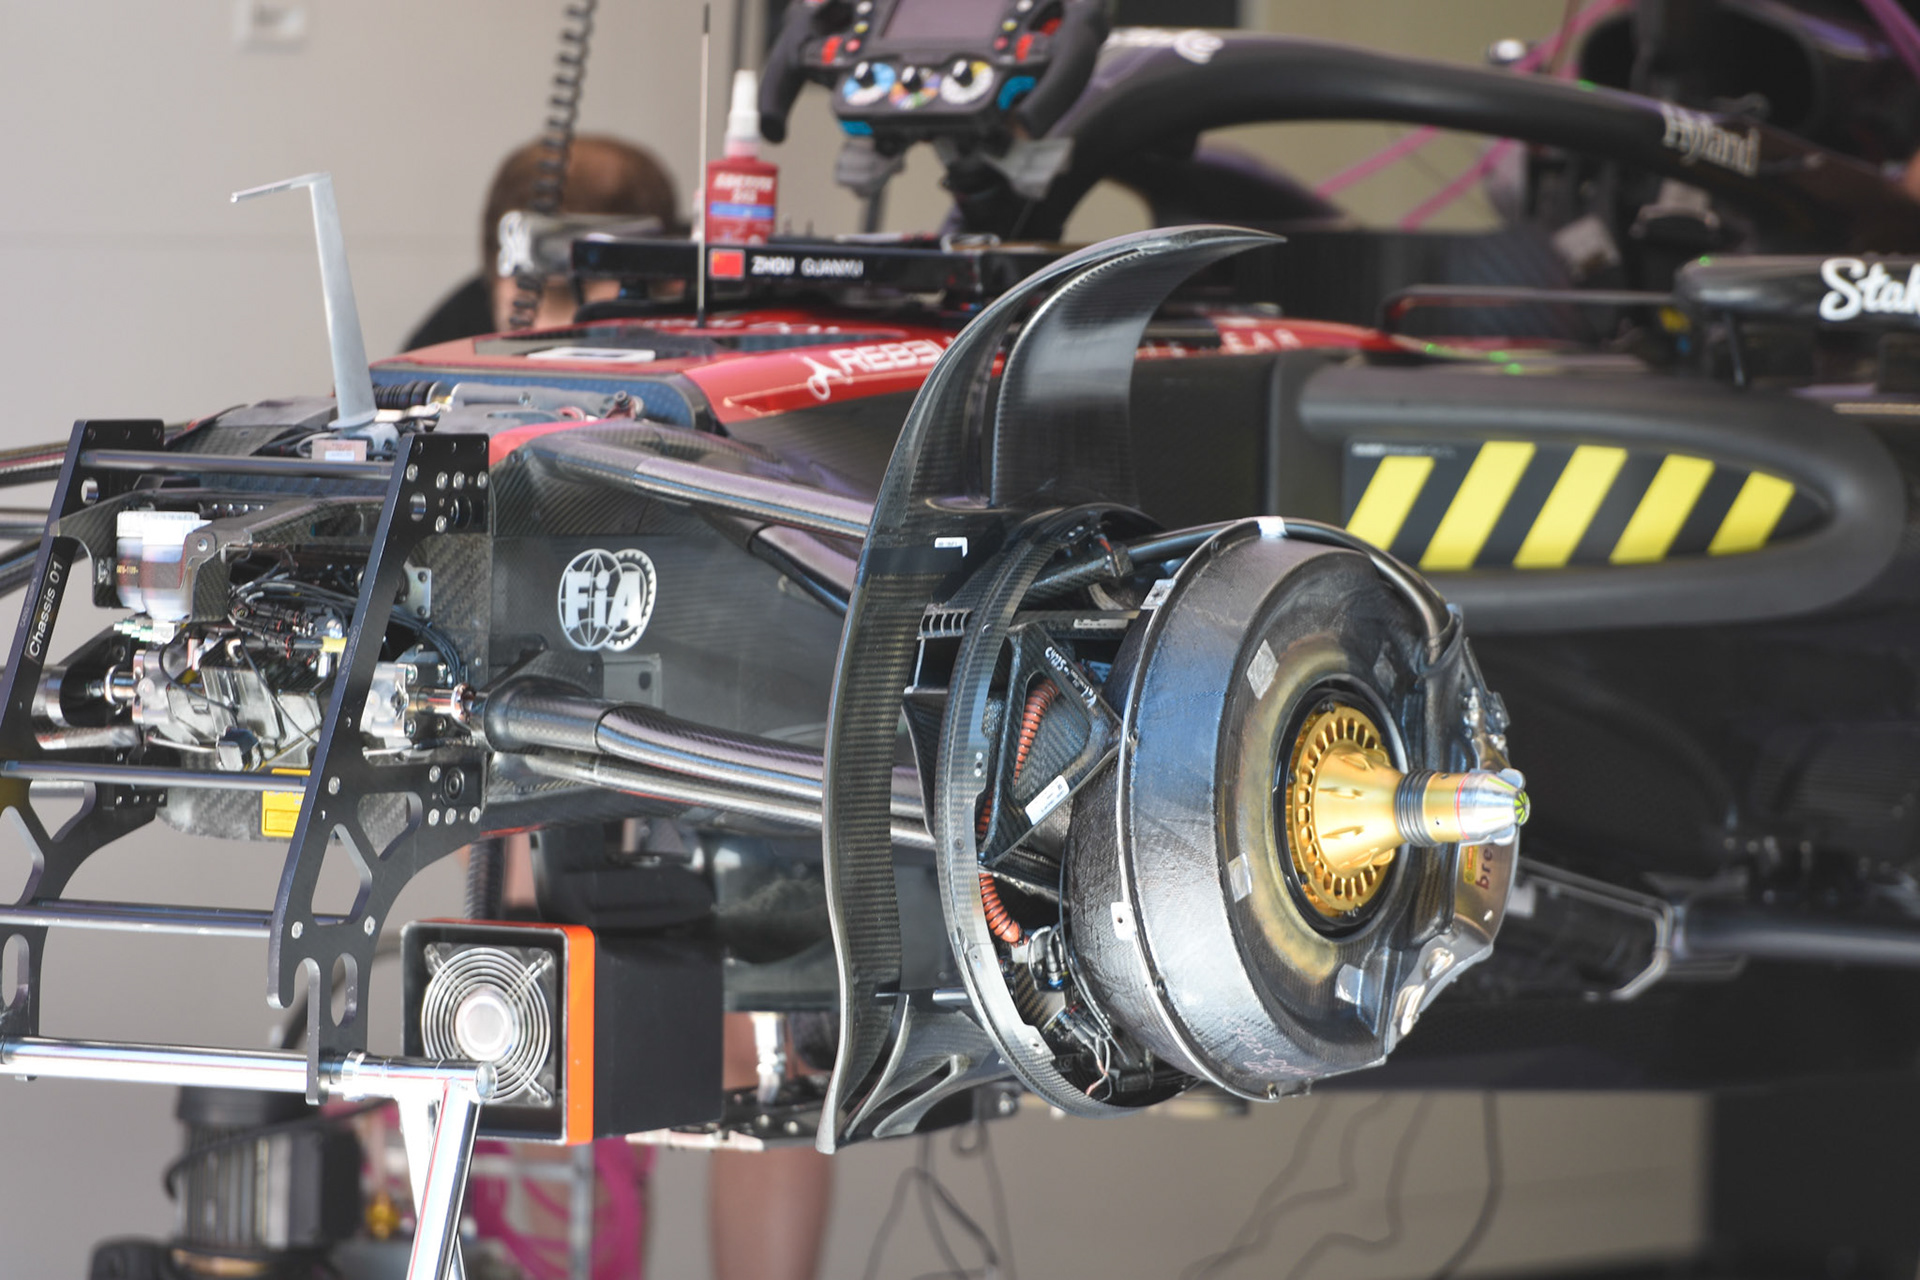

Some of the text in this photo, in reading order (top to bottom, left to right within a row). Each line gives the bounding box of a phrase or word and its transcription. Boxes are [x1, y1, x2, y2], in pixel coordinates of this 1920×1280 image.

[751, 255, 795, 275] ZHOU
[29, 586, 56, 658] Chassis
[49, 560, 63, 584] 01
